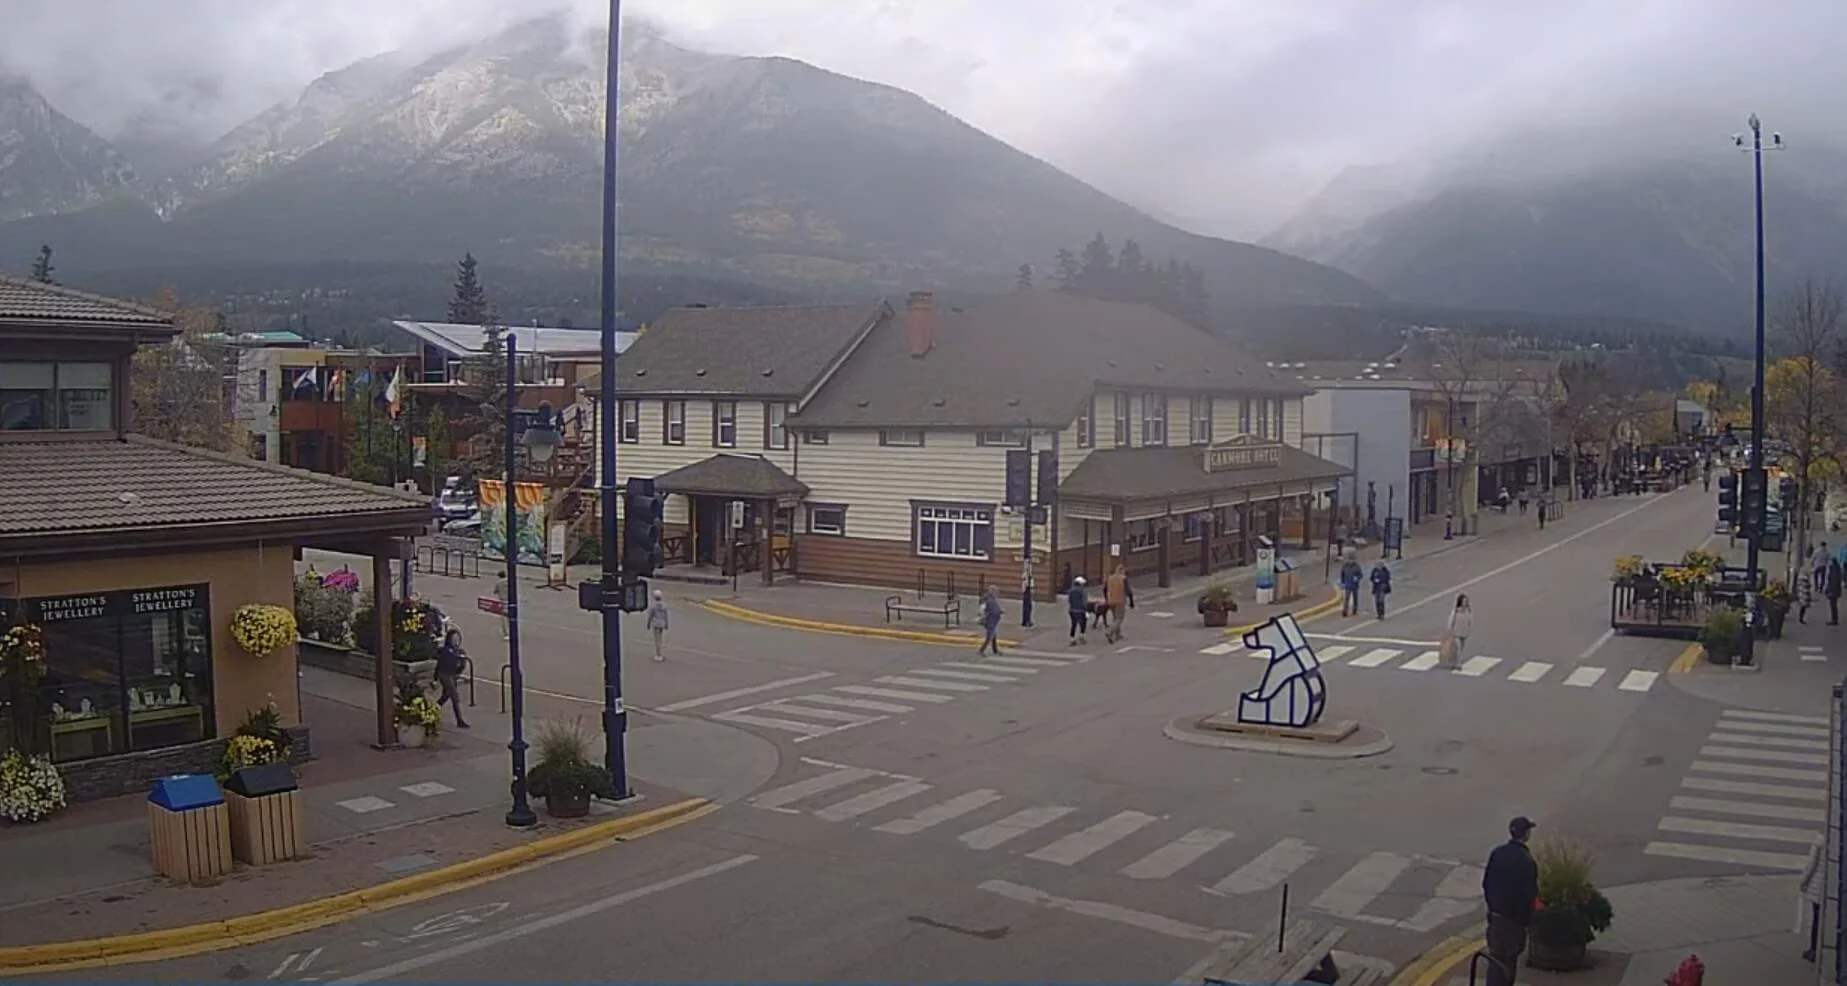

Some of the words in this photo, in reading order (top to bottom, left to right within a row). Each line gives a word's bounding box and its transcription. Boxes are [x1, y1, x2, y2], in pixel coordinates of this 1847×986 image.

[132, 590, 195, 602] STRATTON'S
[40, 597, 106, 610] STRATTON'S
[135, 599, 193, 612] JEWELLERY
[44, 606, 104, 621] JEWELLERY
